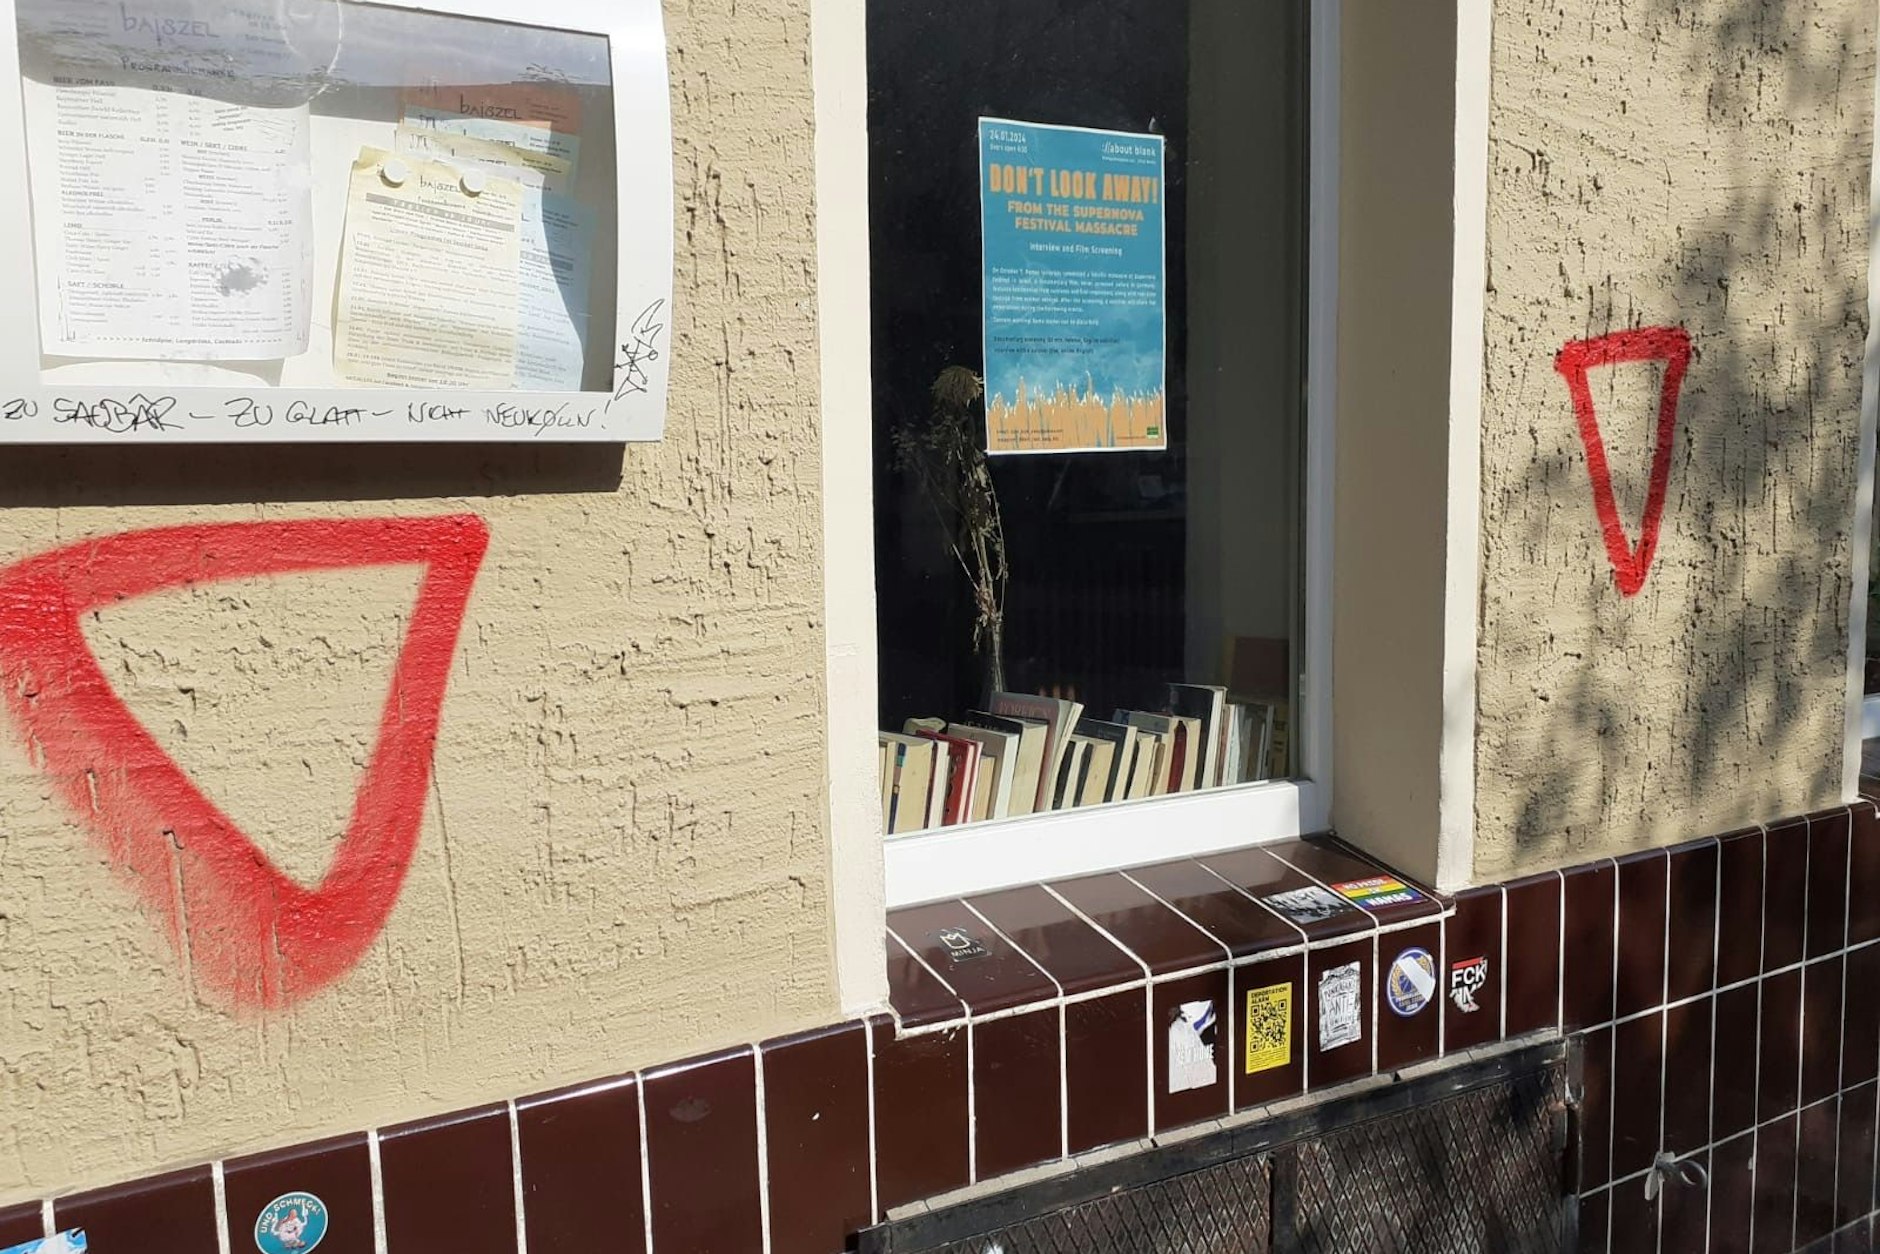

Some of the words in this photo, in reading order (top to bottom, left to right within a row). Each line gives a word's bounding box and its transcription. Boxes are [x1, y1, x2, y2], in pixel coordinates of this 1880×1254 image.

[1134, 144, 1156, 157] blank
[1050, 169, 1097, 199] LOOK
[1103, 173, 1158, 204] AWAY!
[1007, 200, 1042, 214] FROM
[1046, 203, 1069, 217] THE
[1073, 205, 1144, 221] SUPERNOVA
[1015, 217, 1071, 233] FESTIVAL
[1075, 221, 1138, 236] MASSACRE
[1029, 242, 1060, 252] Interview
[1062, 243, 1074, 253] and
[1076, 244, 1090, 254] Film
[1091, 245, 1122, 257] Screening
[1, 398, 38, 420] ZU
[225, 397, 273, 427] ZU
[1451, 964, 1485, 989] FCK
